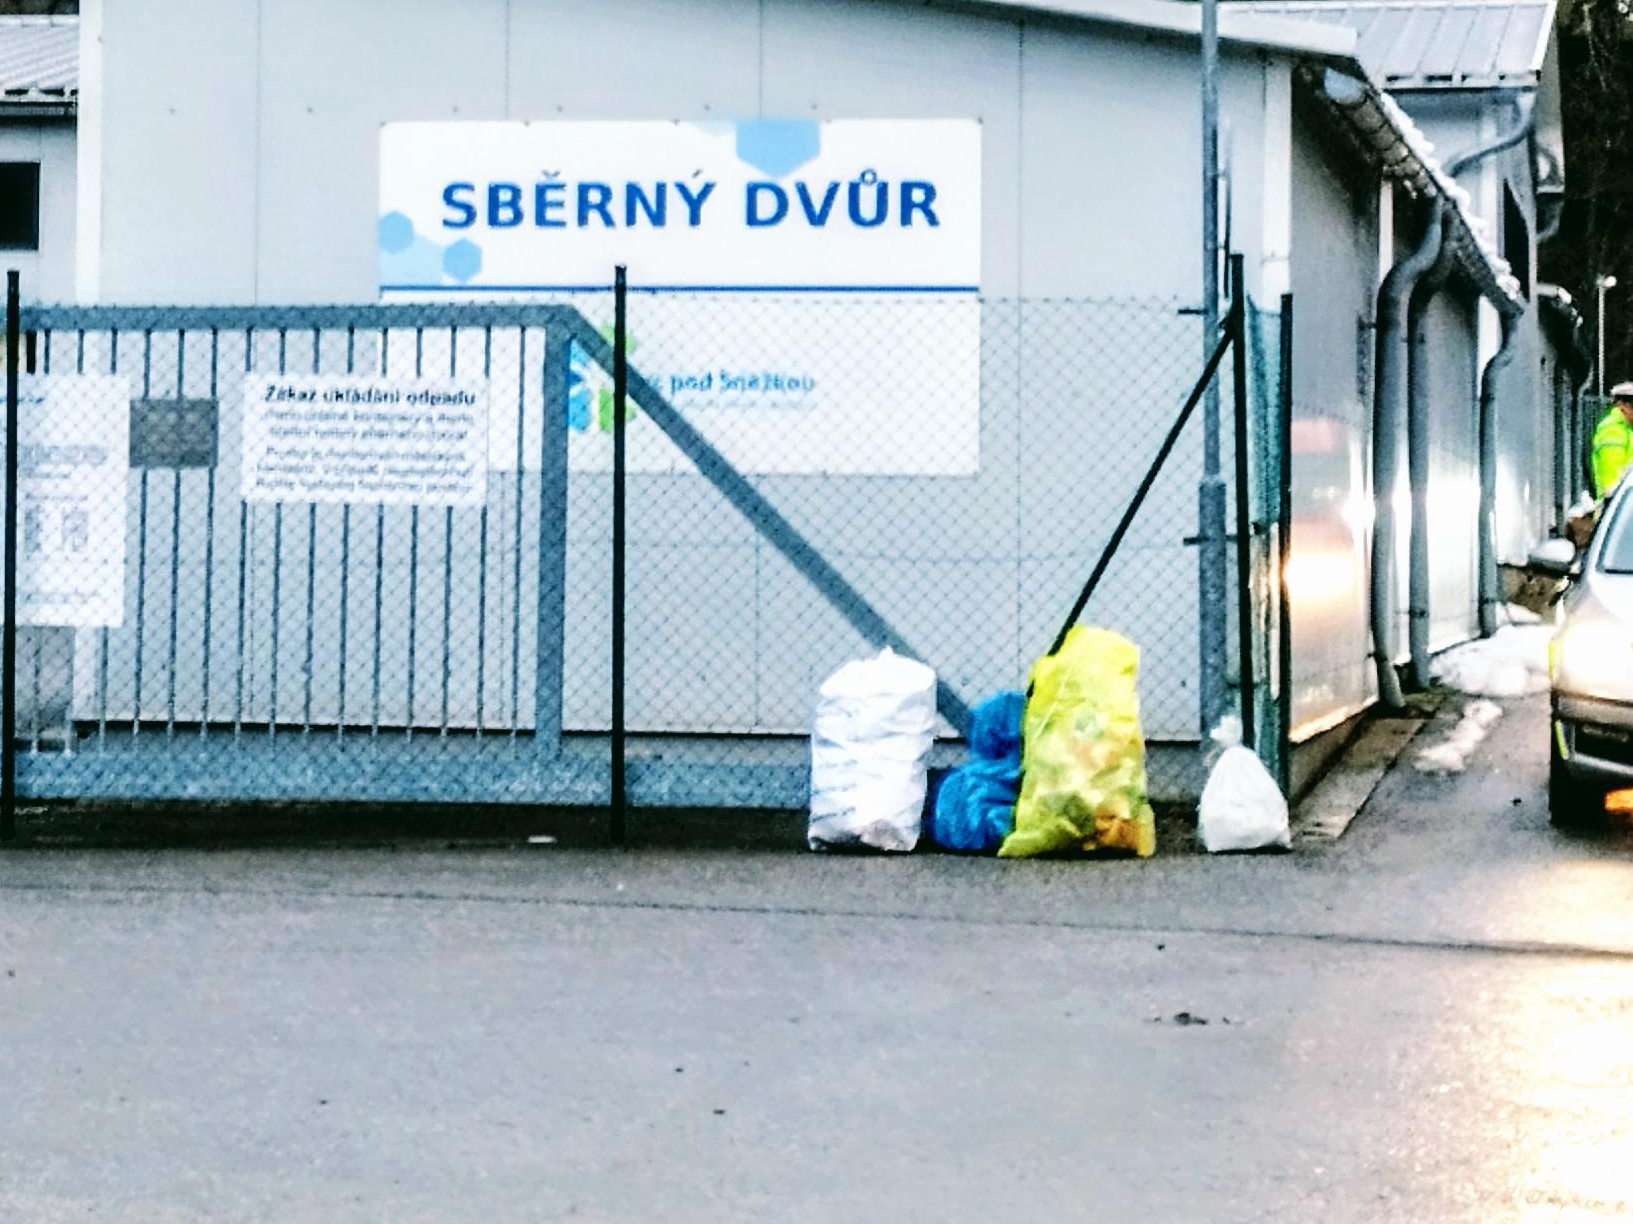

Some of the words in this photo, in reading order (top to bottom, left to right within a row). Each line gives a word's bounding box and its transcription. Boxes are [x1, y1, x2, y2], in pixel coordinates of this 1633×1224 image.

[441, 169, 716, 229] SBĚRNÝ
[745, 168, 941, 229] DVŮR
[670, 373, 712, 395] pod
